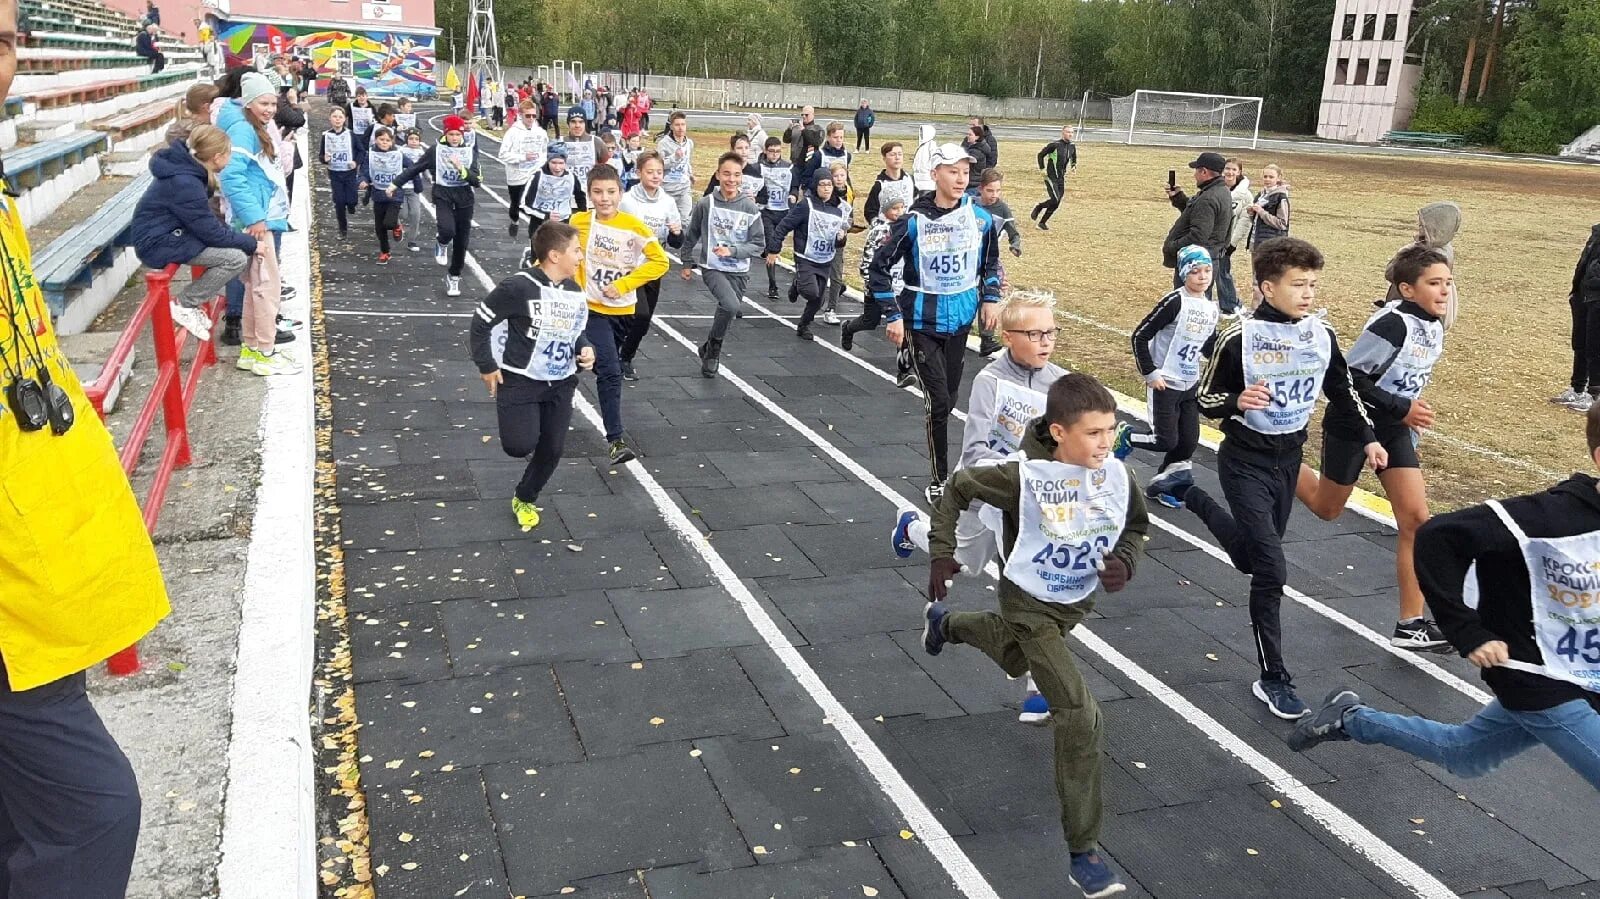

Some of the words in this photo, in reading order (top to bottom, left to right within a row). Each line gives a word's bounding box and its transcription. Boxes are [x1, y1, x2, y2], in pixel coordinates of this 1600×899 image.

[930, 252, 968, 274] 4551
[1026, 478, 1066, 492] КРОСС
[1034, 490, 1079, 505] АЦИИ
[1041, 505, 1074, 523] 021
[1542, 555, 1592, 576] КРОСС
[1556, 625, 1600, 665] 45
